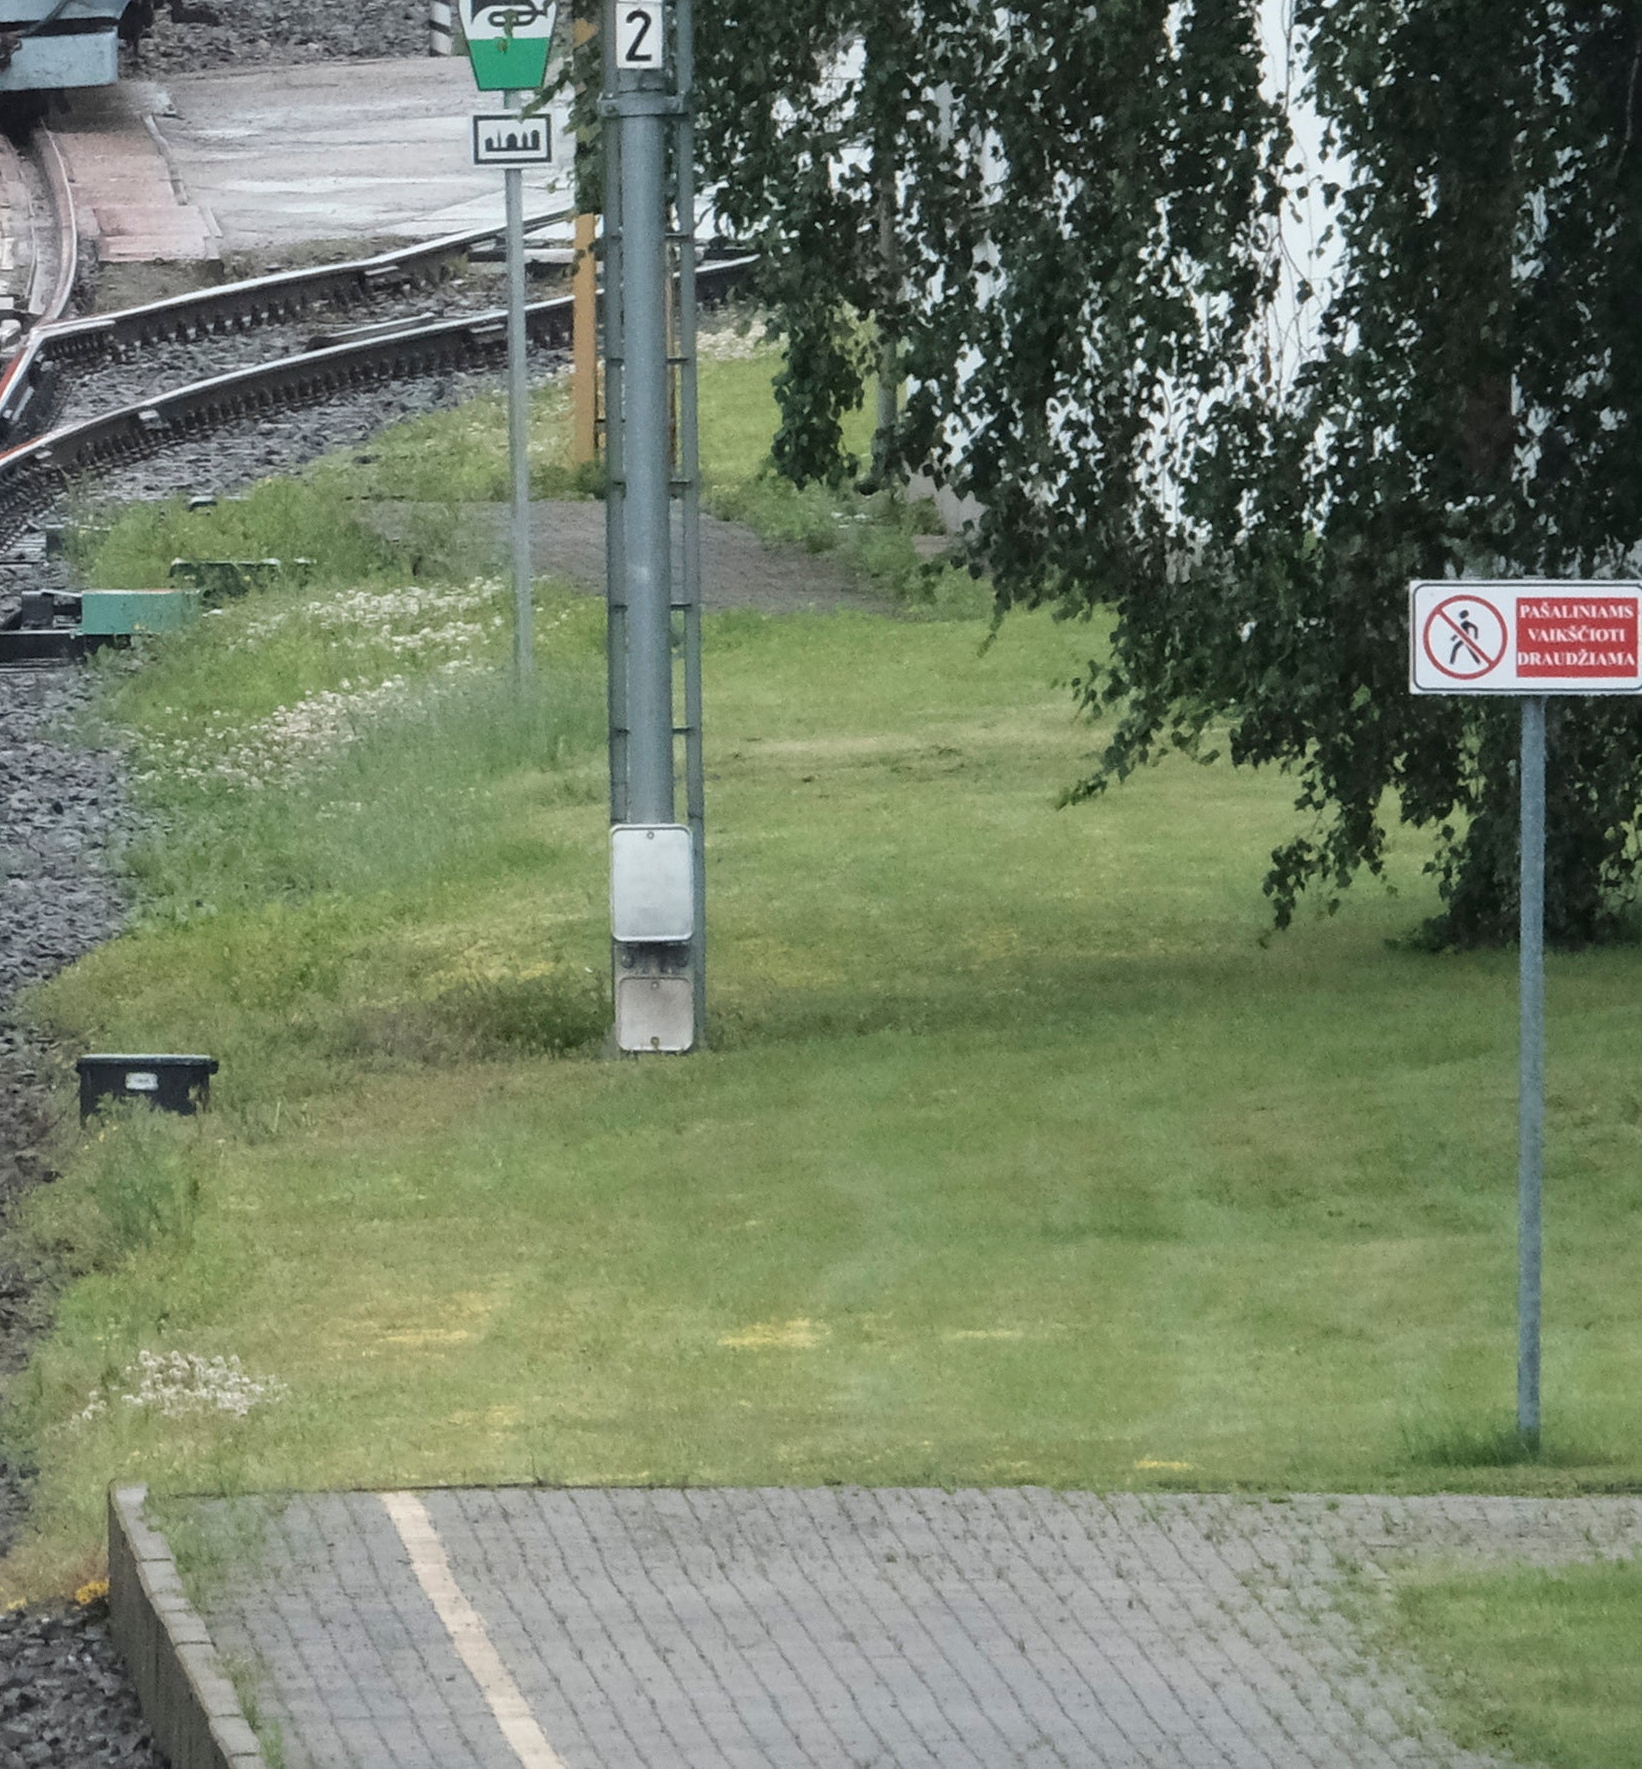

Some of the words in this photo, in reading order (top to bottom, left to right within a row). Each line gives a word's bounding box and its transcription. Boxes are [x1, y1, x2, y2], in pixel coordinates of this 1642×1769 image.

[1520, 601, 1634, 619] PAŠALINIAMS
[1528, 625, 1626, 643] VAIKŠČIOTI
[1517, 649, 1636, 667] DRAUDŽIAMA
